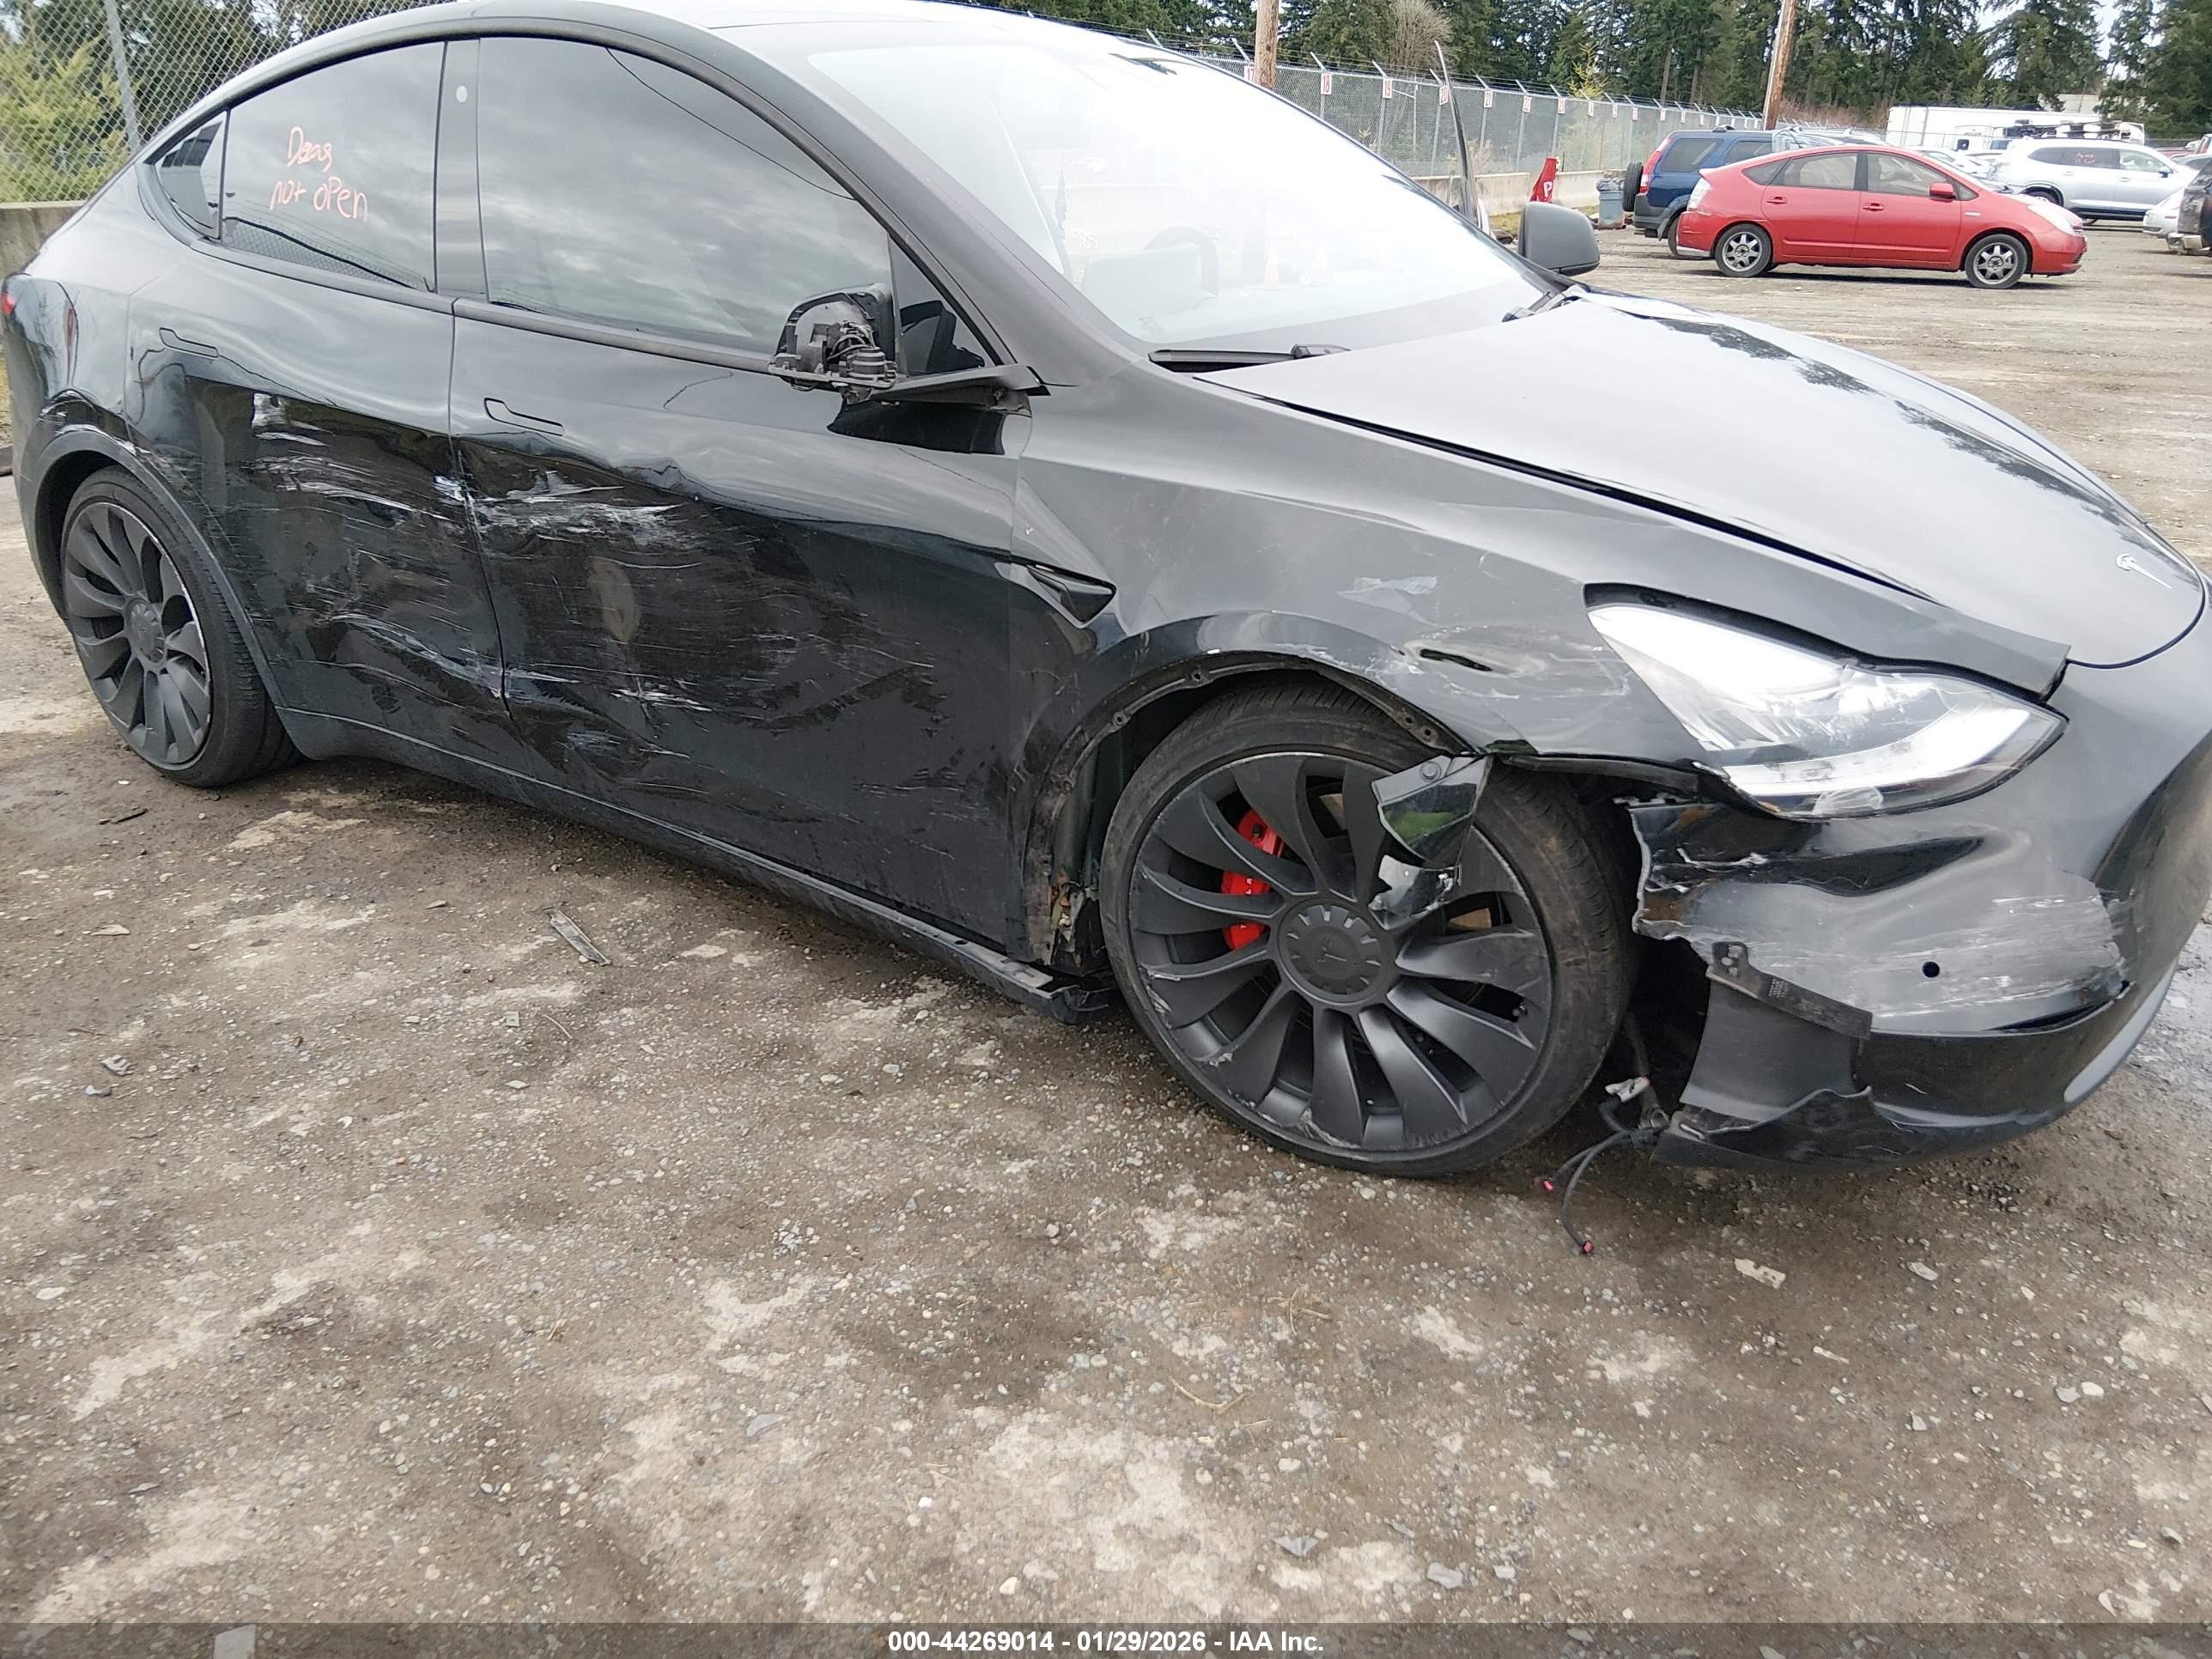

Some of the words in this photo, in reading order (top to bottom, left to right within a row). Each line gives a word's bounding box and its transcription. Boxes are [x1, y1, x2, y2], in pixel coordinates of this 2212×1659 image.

[1322, 74, 1330, 94] 18
[1384, 78, 1391, 97] 19
[1441, 86, 1449, 104] 20
